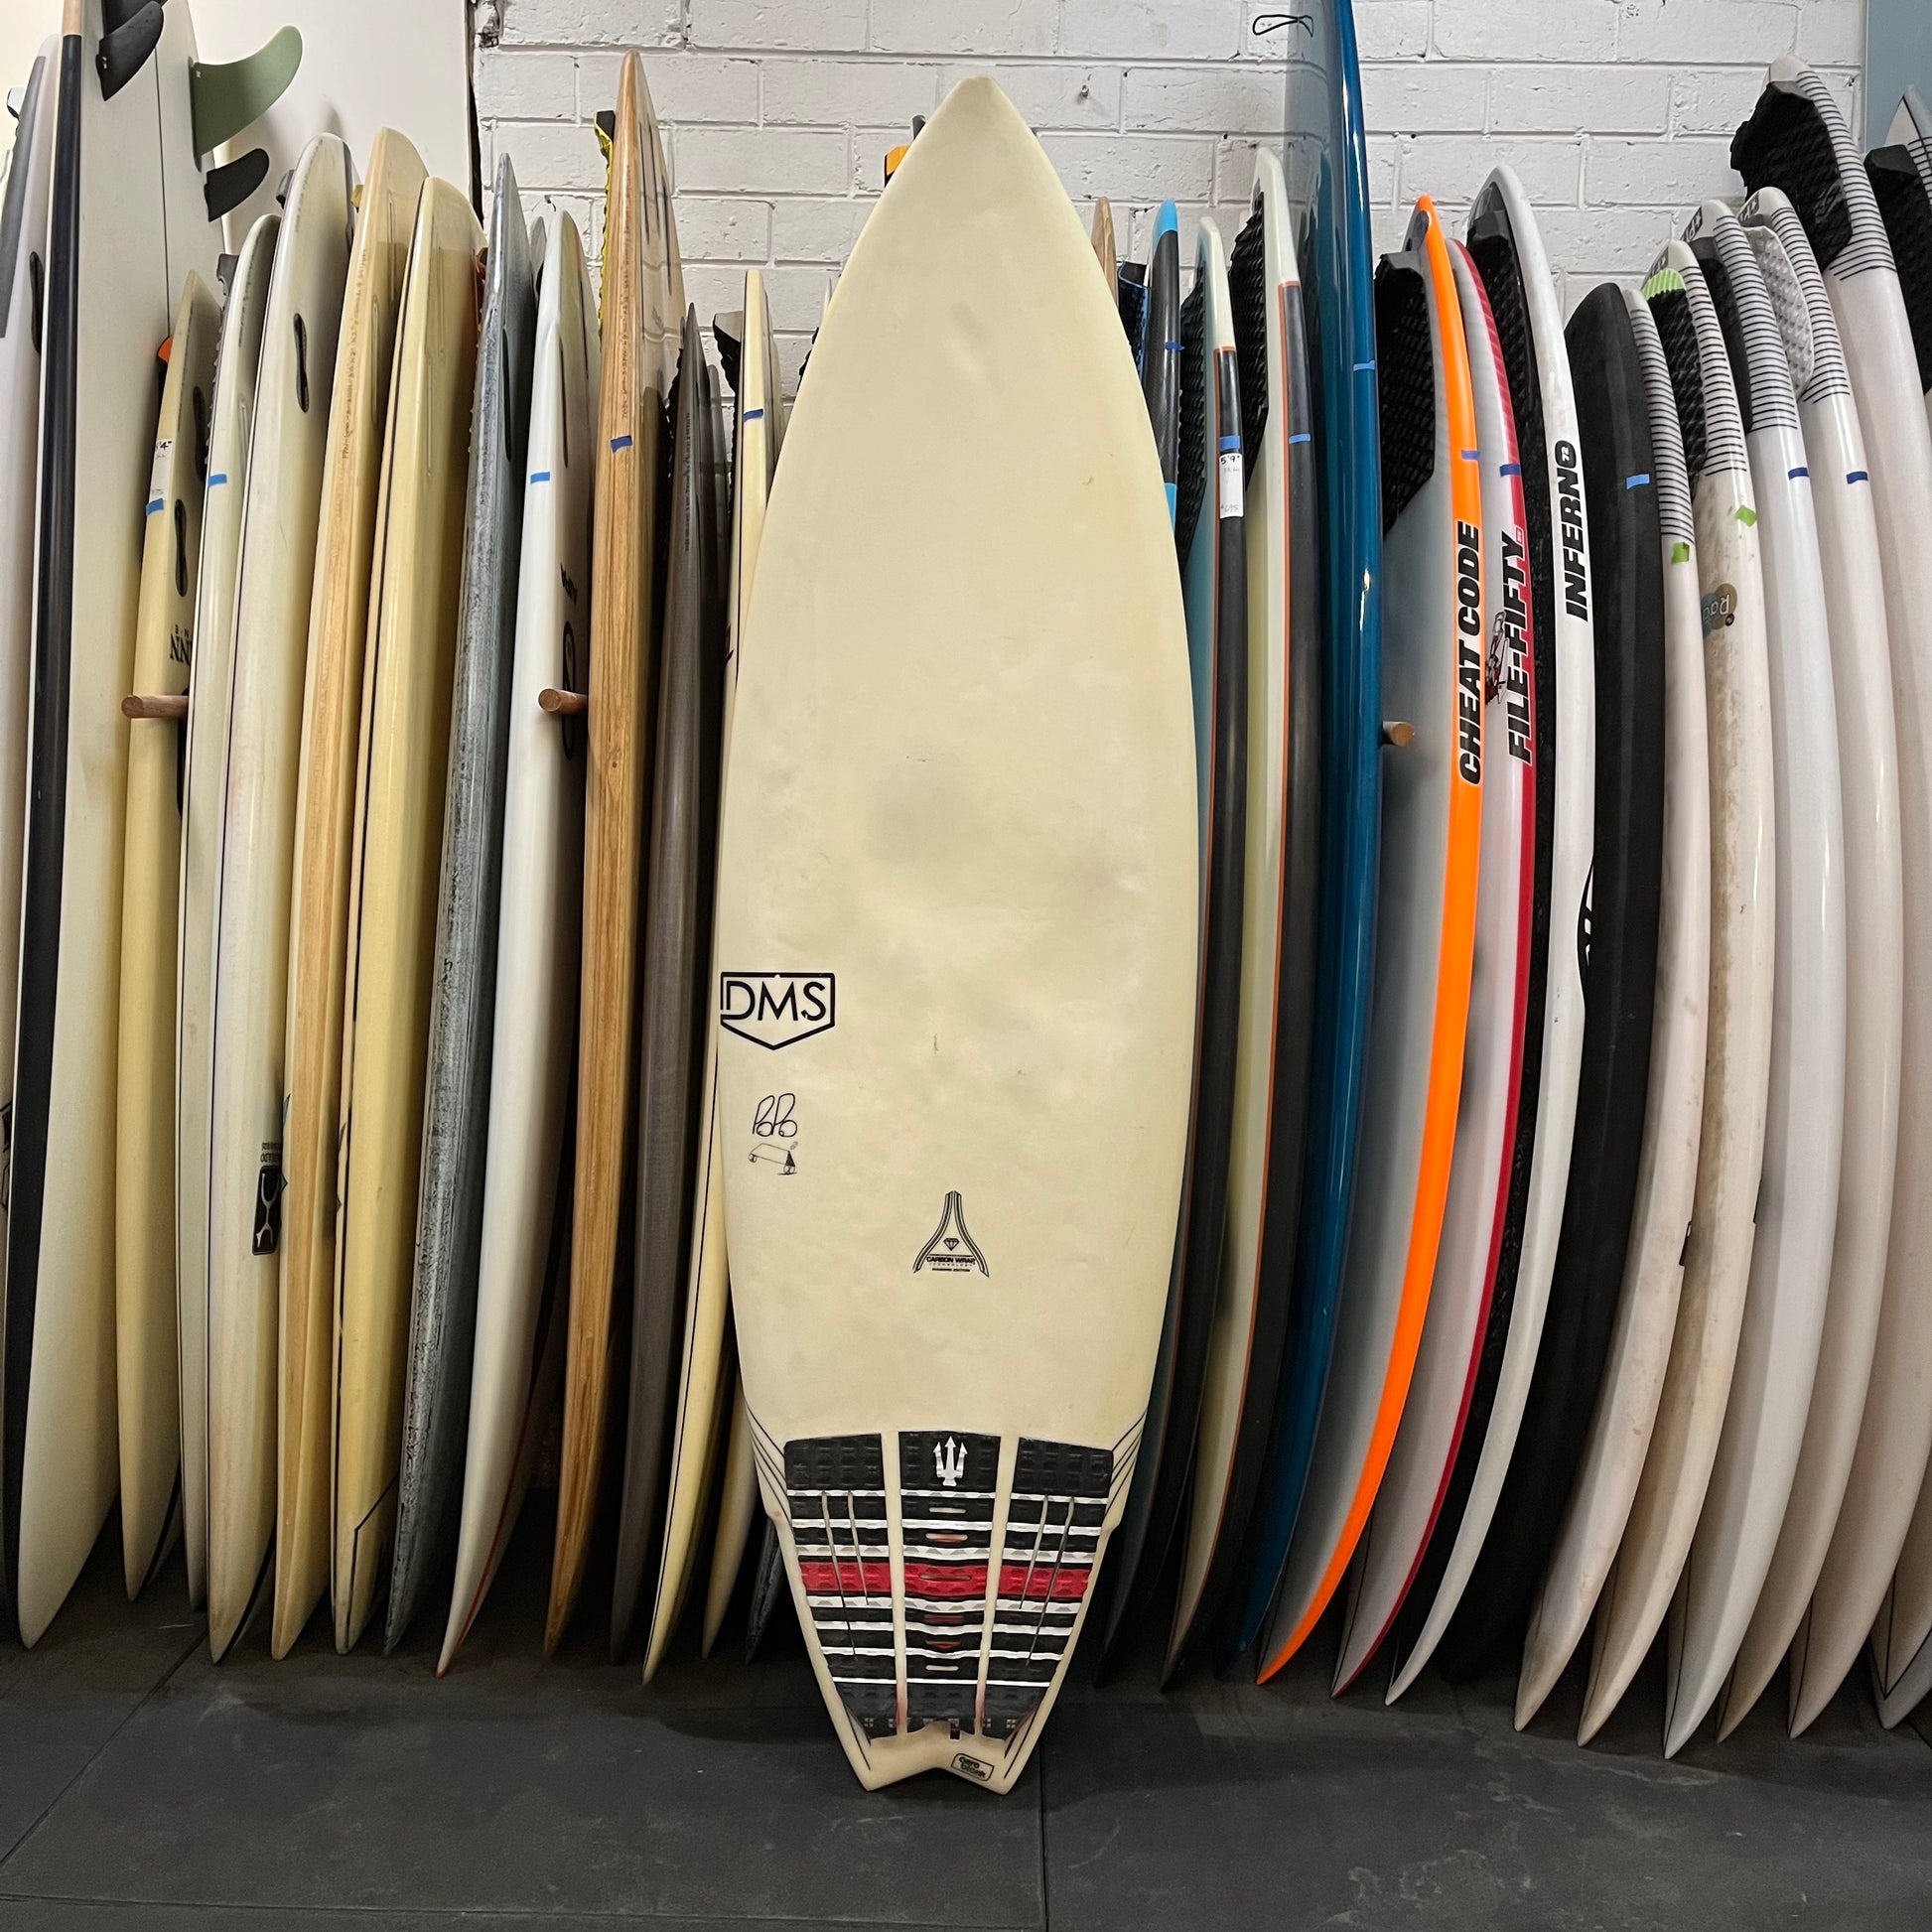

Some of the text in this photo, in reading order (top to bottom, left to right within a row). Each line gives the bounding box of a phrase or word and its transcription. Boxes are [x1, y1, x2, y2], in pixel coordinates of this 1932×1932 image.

[1555, 440, 1588, 622] INFERNO
[1457, 520, 1480, 784] CHEAT CODE
[1501, 530, 1531, 763] FILE-FIFTY
[726, 980, 827, 1022] DMS
